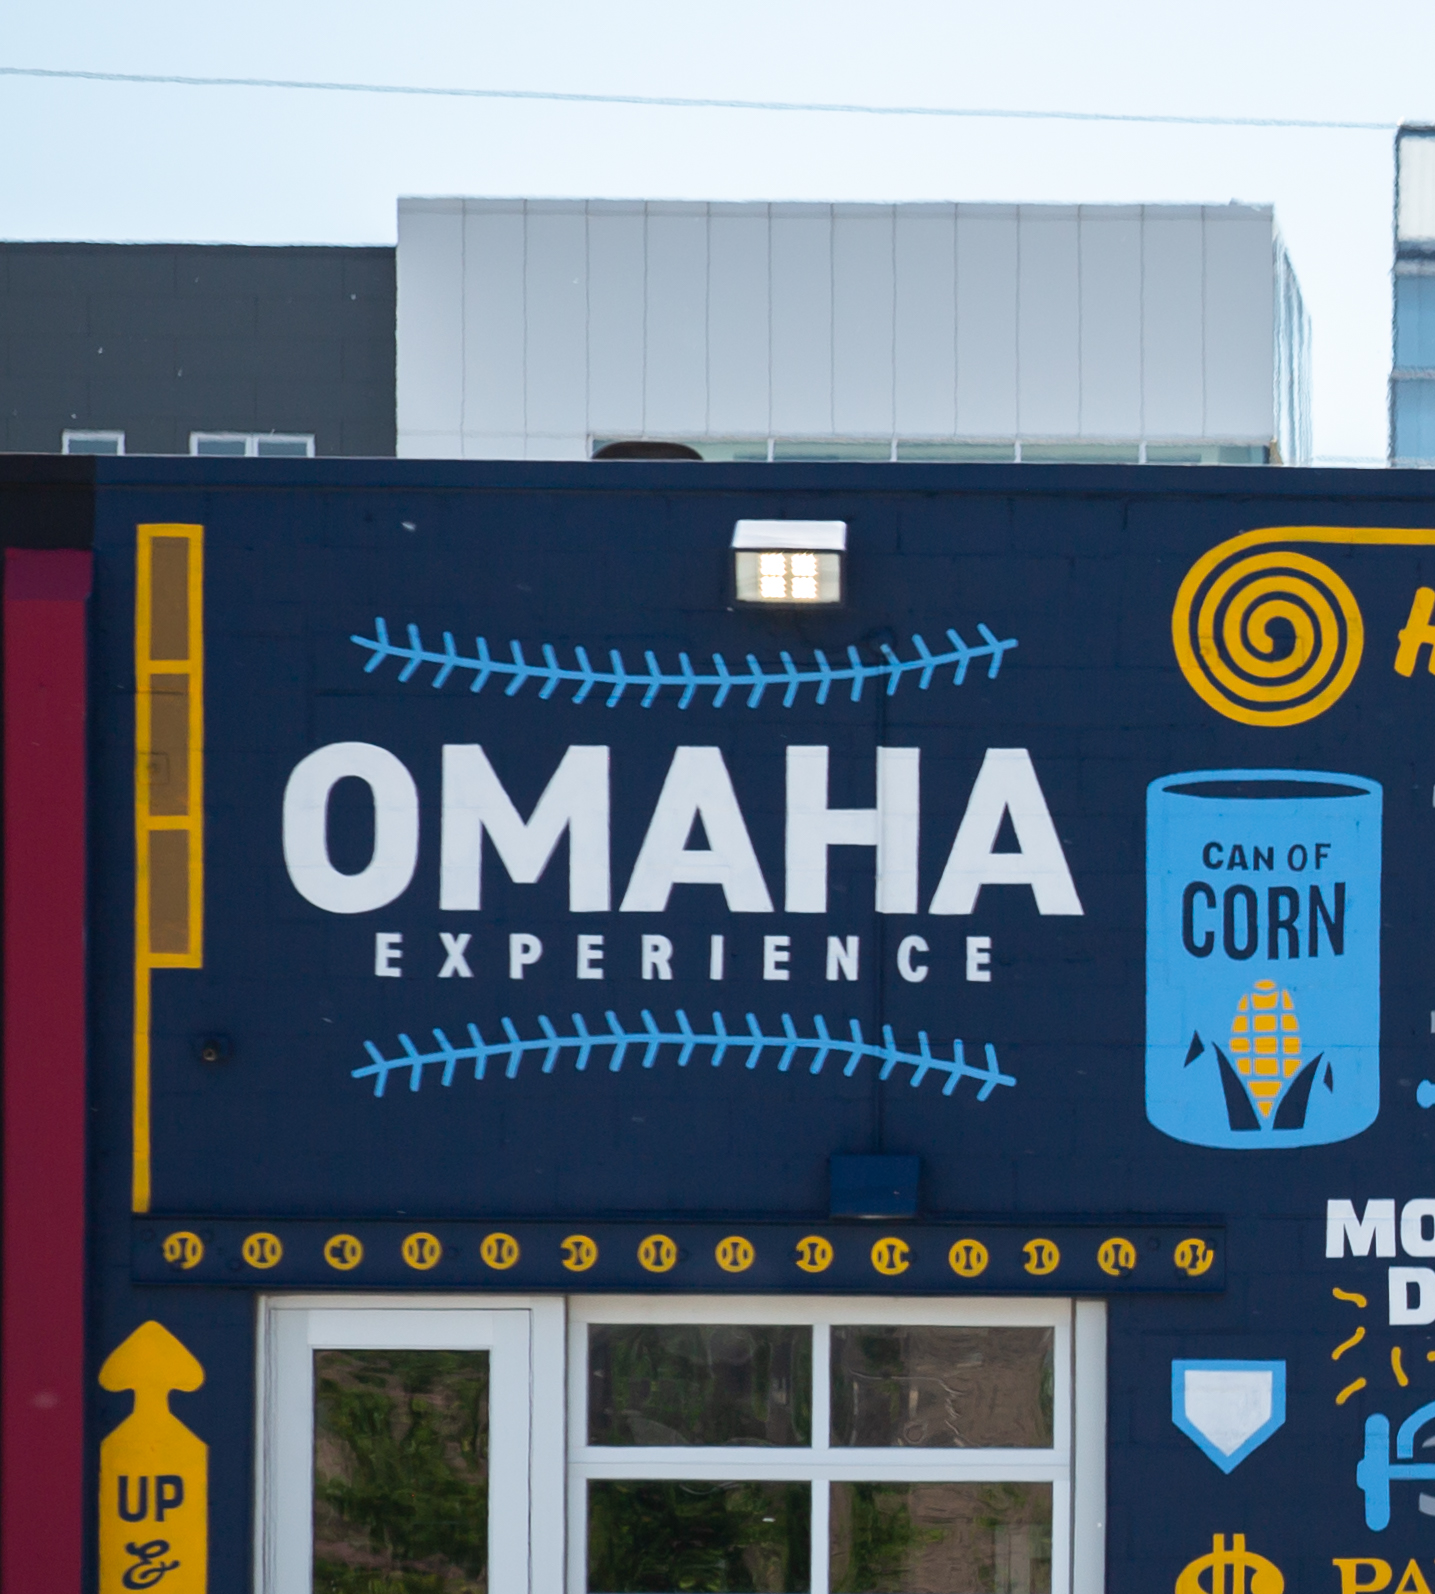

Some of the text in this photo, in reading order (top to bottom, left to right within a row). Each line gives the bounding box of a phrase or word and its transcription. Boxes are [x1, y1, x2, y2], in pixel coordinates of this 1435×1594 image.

[283, 741, 1084, 915] OMAHA
[1203, 841, 1331, 871] CAN OF
[1182, 881, 1345, 961] CORN
[375, 933, 992, 982] EXPERIENCE
[117, 1474, 183, 1523] UP
[121, 1538, 180, 1590] &
